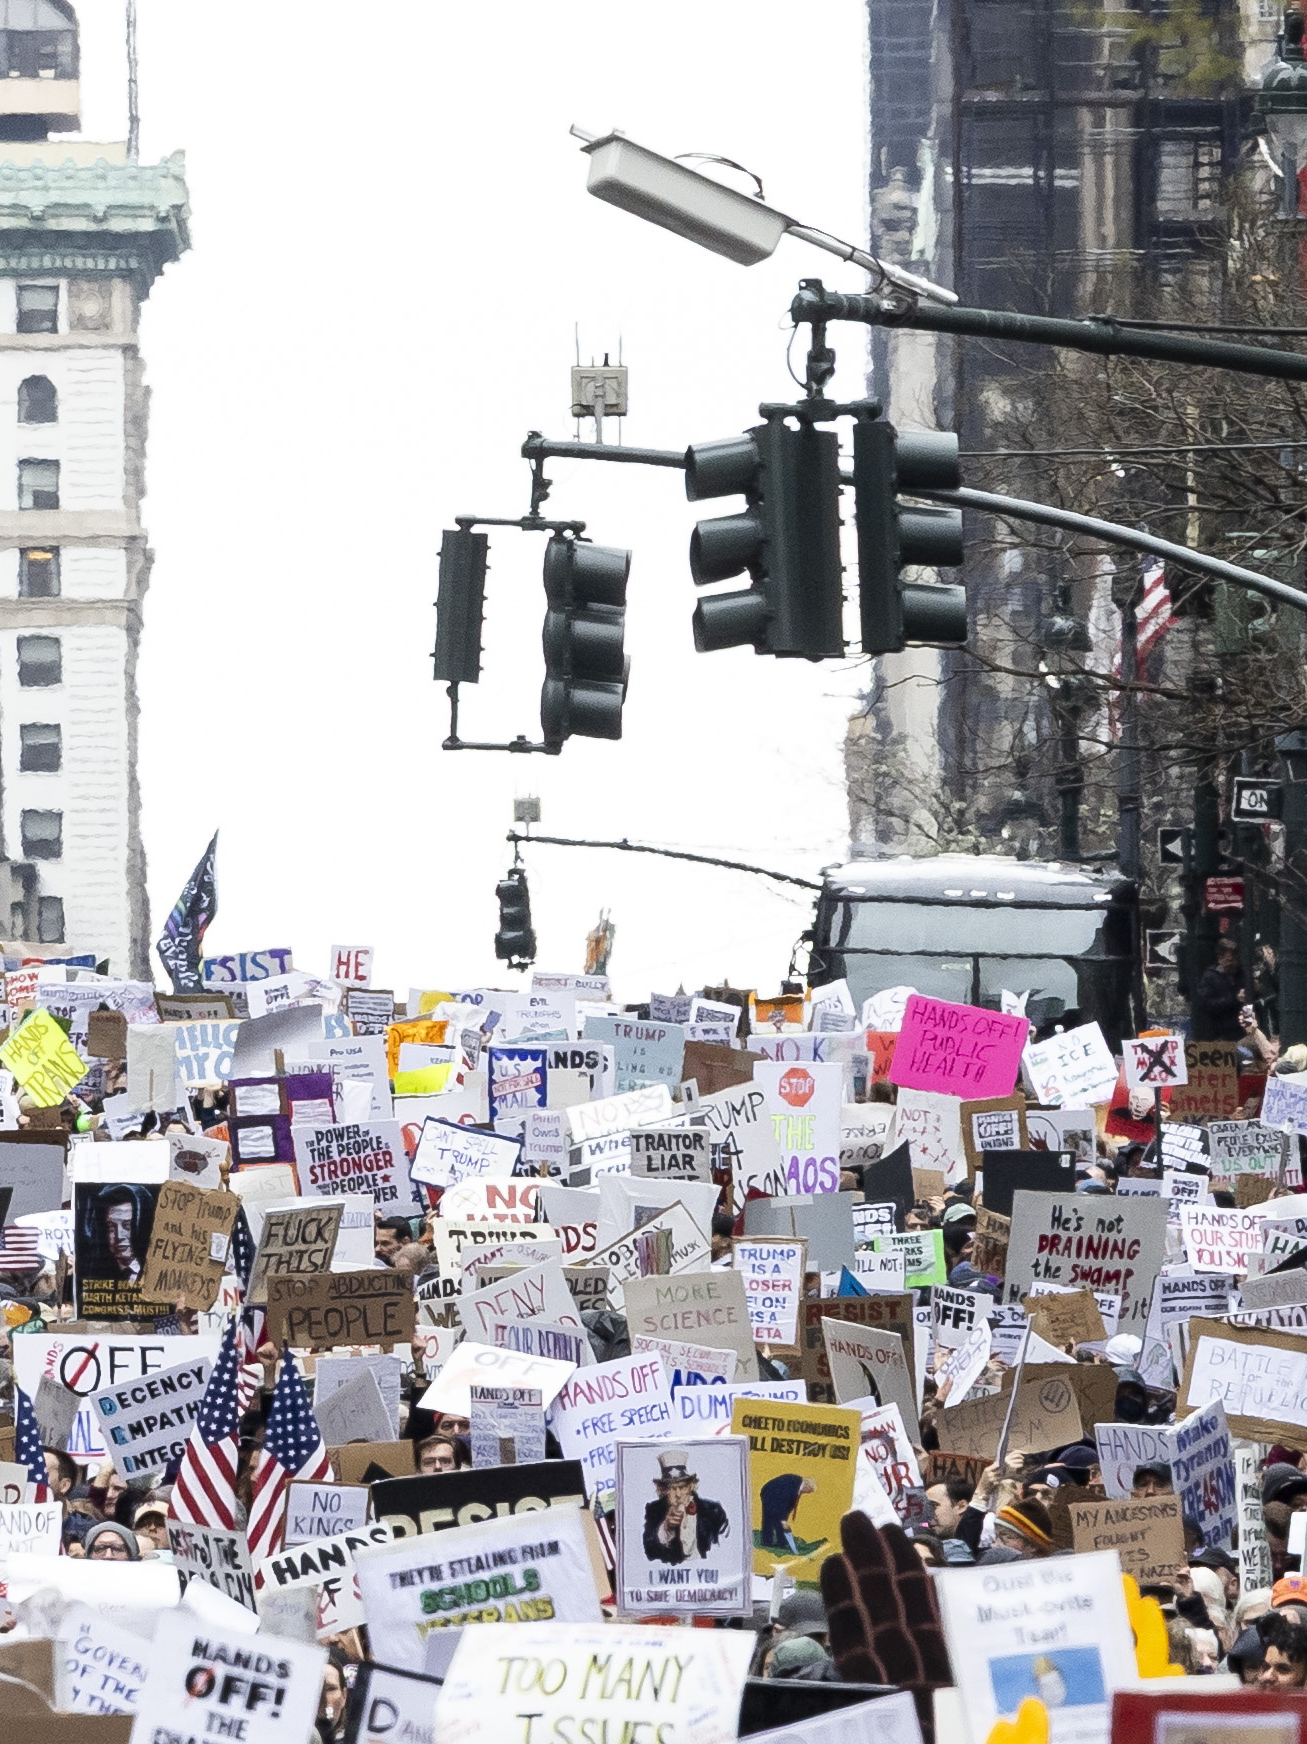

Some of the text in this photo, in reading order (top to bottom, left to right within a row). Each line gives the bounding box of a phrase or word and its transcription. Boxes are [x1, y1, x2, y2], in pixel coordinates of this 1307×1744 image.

[336, 958, 368, 982] HE
[614, 1023, 667, 1042] TRUMP
[911, 1003, 1021, 1039] HANDS OFF!
[7, 1015, 49, 1062] HANDS
[917, 1029, 994, 1060] PUBLIC
[27, 1043, 47, 1066] OFF
[1057, 1043, 1094, 1068] ICE
[1186, 1045, 1236, 1068] Seen
[24, 1040, 88, 1108] TRANS
[177, 1055, 210, 1081] MY
[910, 1054, 986, 1081] HEALTH
[780, 1077, 814, 1095] STOP
[498, 1092, 538, 1112] MAIL
[900, 1108, 931, 1124] NOT
[315, 1125, 362, 1146] POWER
[632, 1133, 704, 1153] TRAITOR
[772, 1114, 815, 1151] THE
[309, 1136, 382, 1161] THE PEOPLE
[465, 1136, 497, 1156] SPELL
[309, 1150, 394, 1185] STRONGER
[647, 1154, 695, 1172] LIAR
[331, 1174, 378, 1195] PEOPLE
[160, 1187, 231, 1224] STOP Trump
[267, 1215, 330, 1247] FUCK
[1051, 1205, 1123, 1236] He's not
[1188, 1211, 1237, 1228] HANDS
[163, 1220, 208, 1244] and his
[891, 1235, 922, 1246] THREE
[1191, 1229, 1225, 1247] OUR
[153, 1237, 207, 1267] FLYING
[740, 1248, 796, 1262] TRUMP
[1037, 1234, 1140, 1260] DRAINING
[1193, 1248, 1222, 1265] YOU
[260, 1246, 331, 1275] THIS!
[751, 1263, 782, 1275] IS A
[1031, 1257, 1061, 1280] the
[82, 1279, 115, 1290] STRIKE
[272, 1278, 320, 1300] STOP
[655, 1281, 723, 1305] MORE
[1162, 1280, 1204, 1294] HANDS
[1205, 1280, 1227, 1291] OFF
[287, 1301, 403, 1339] PEOPLE
[643, 1305, 739, 1333] SCIENCE
[807, 1299, 899, 1326] RESIST
[935, 1307, 974, 1331] OFF!
[830, 1339, 873, 1361] HANDS
[1210, 1345, 1290, 1376] BATTLE
[59, 1343, 165, 1397] OFF
[97, 1366, 205, 1416] DECENCY
[471, 1386, 543, 1403] HANDS OFF
[558, 1374, 628, 1411] HANDS
[631, 1360, 661, 1393] OFF
[581, 1397, 670, 1437] FREE SPEECH
[742, 1414, 788, 1430] CHEETO
[1176, 1413, 1220, 1450] Make
[1097, 1432, 1170, 1462] HANDS
[1172, 1439, 1229, 1481] Tyranny
[312, 1491, 341, 1514] NO
[37, 1511, 57, 1534] OF
[293, 1515, 354, 1535] KINGS
[1076, 1511, 1100, 1528] MY
[390, 1549, 518, 1590] THEY'RE STEALING
[649, 1568, 720, 1584] I WANT YOU
[421, 1567, 542, 1613] SCHOOLS
[629, 1586, 739, 1604] TO DEMOCRACY!
[191, 1636, 291, 1680] HANDS
[100, 1674, 140, 1703] THE
[497, 1653, 694, 1703] TOO MANY
[185, 1666, 286, 1718] OFF!
[205, 1711, 249, 1742] THE
